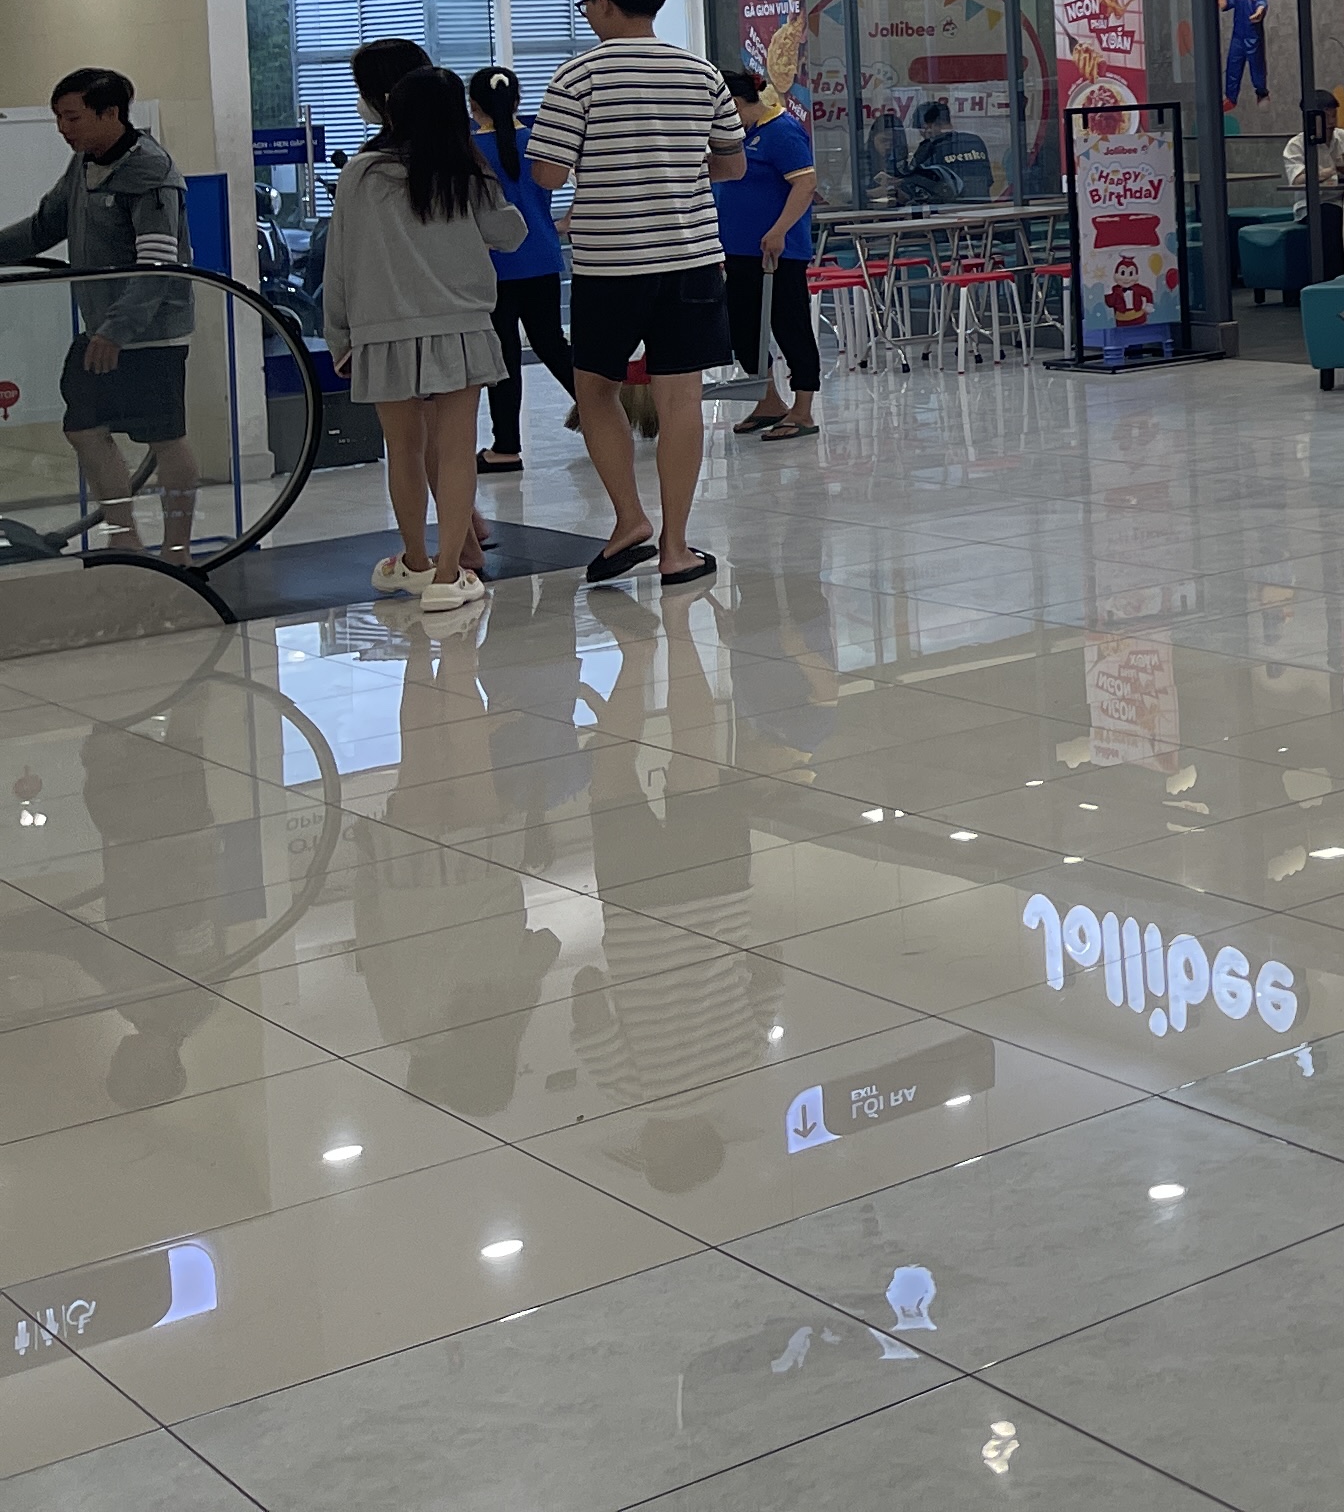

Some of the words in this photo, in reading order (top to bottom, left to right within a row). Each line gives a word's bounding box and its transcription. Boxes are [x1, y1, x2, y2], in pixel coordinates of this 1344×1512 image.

[868, 20, 936, 39] Jollibee
[812, 95, 915, 124] Birday
[1098, 169, 1141, 187] Happy
[1089, 179, 1163, 207] Birthday
